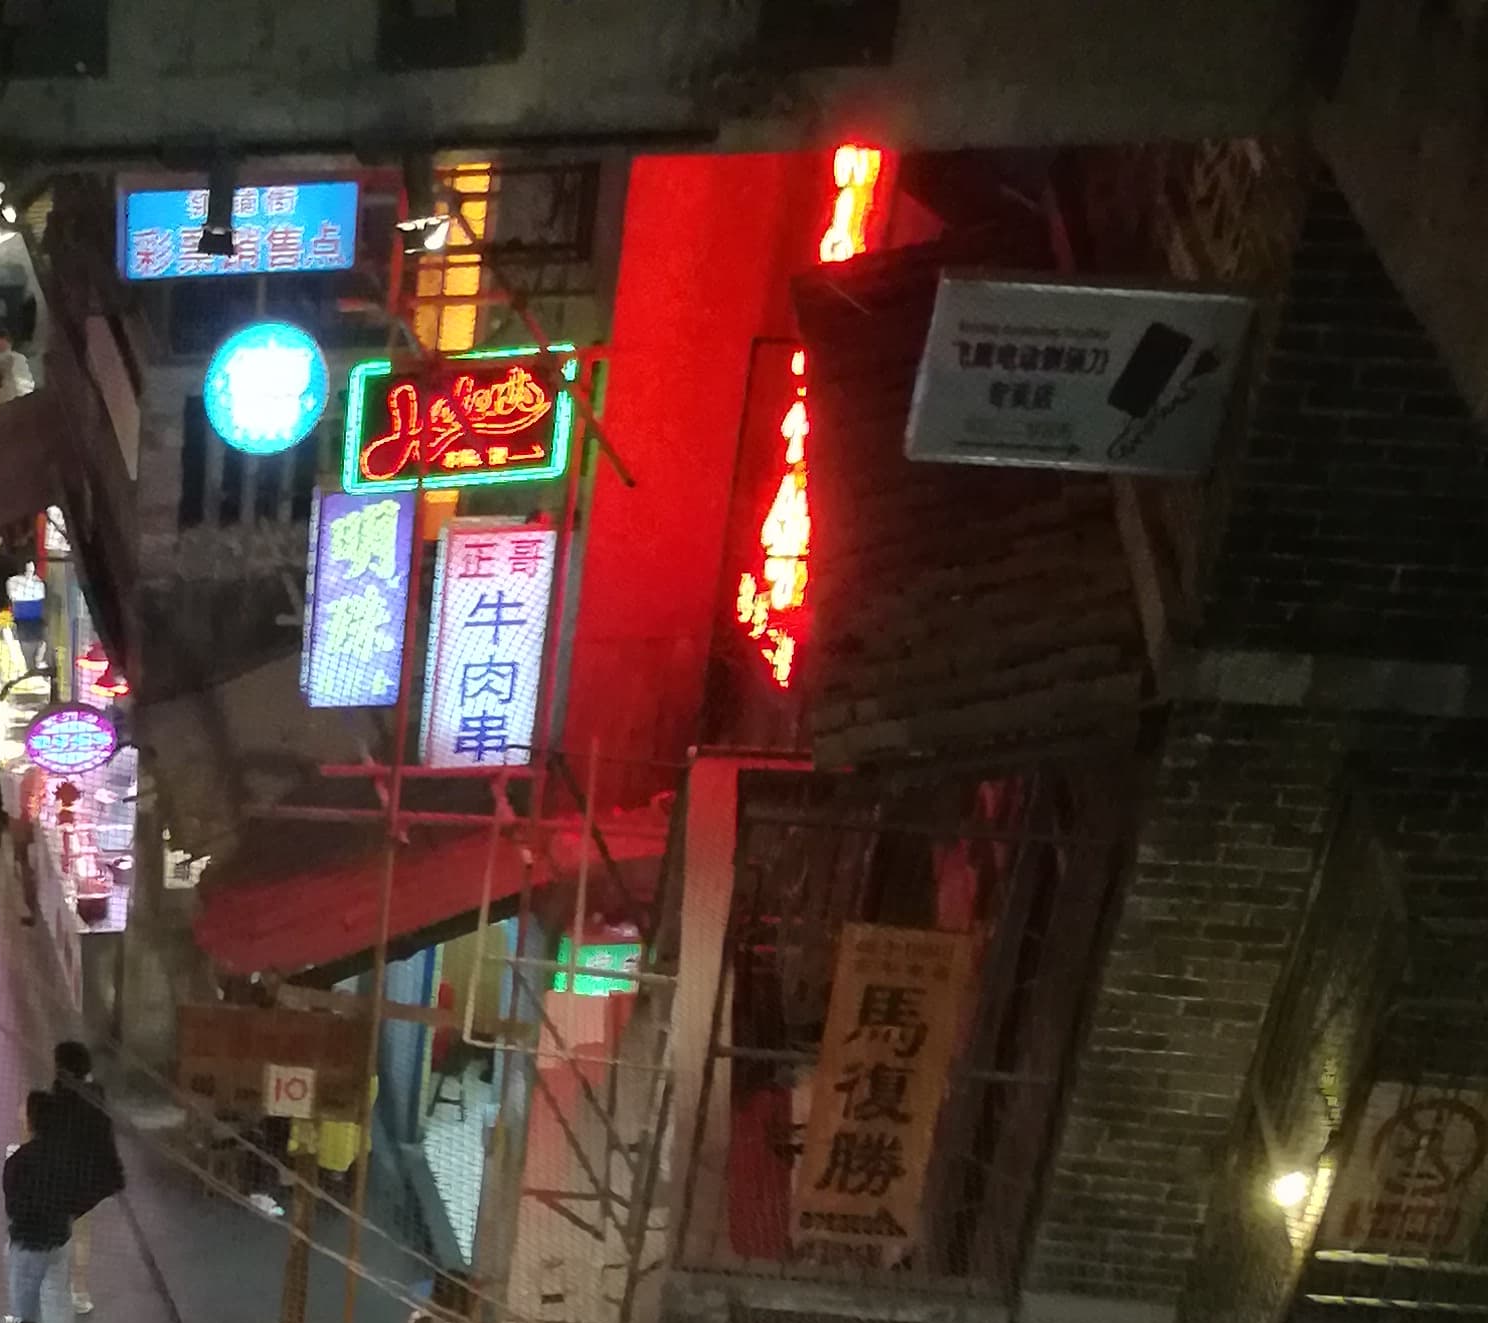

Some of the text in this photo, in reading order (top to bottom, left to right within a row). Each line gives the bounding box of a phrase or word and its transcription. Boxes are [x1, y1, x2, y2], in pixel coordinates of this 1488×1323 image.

[459, 537, 548, 581] 正哥
[454, 588, 530, 762] 牛肉串
[274, 1077, 309, 1103] 10
